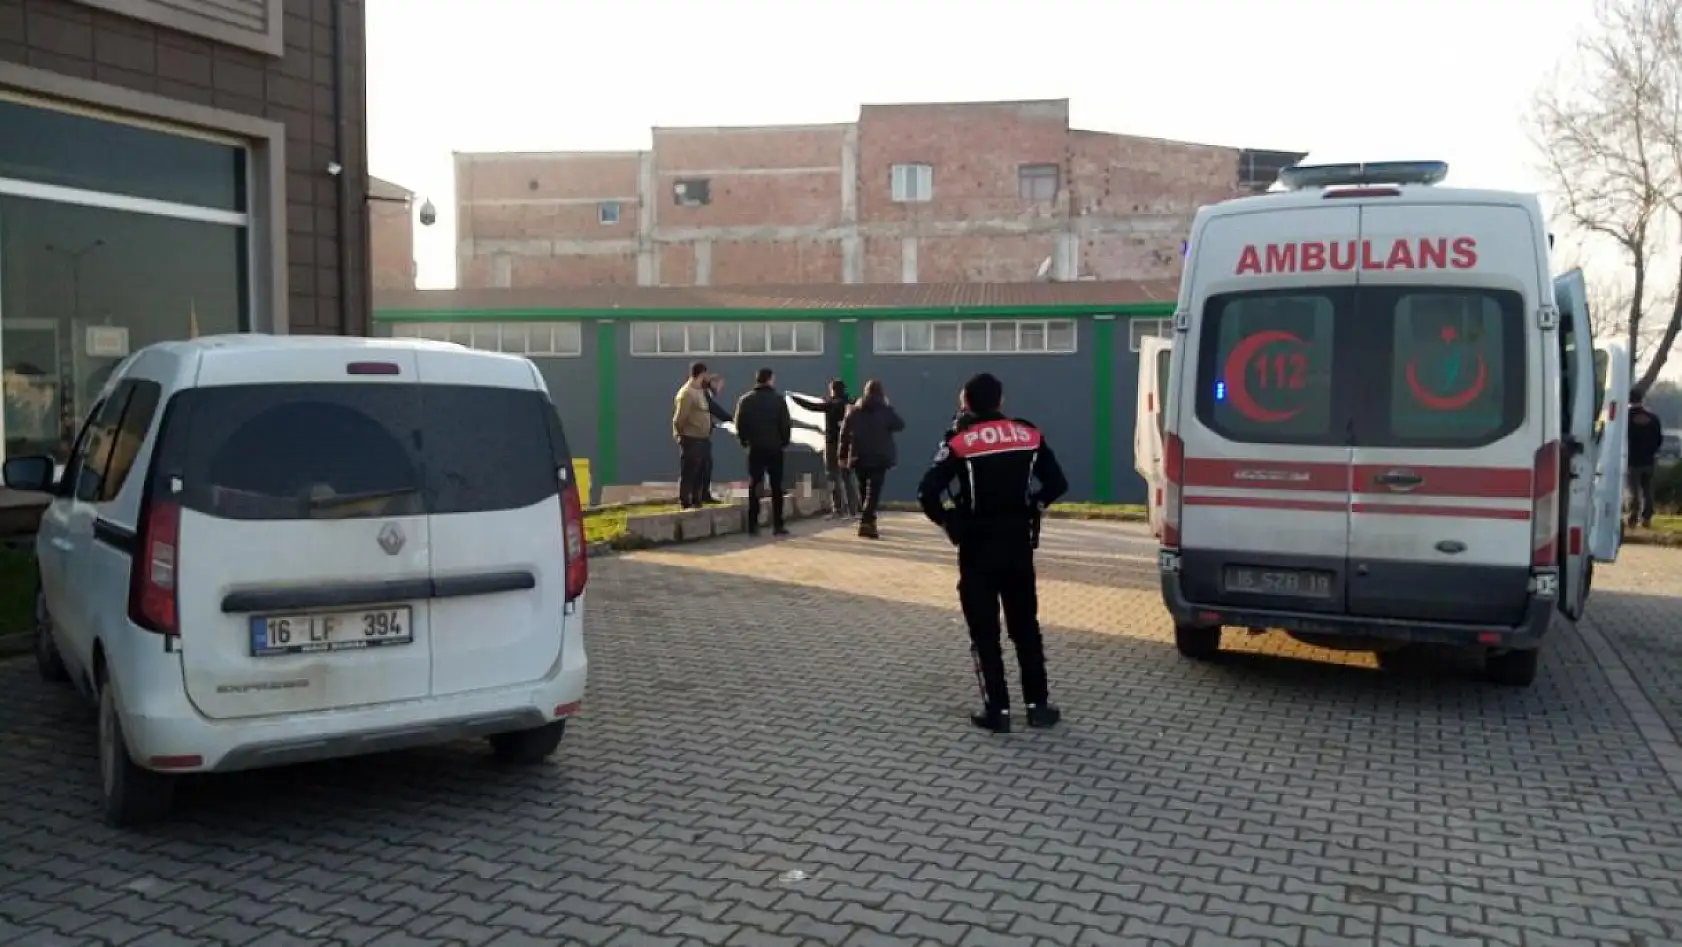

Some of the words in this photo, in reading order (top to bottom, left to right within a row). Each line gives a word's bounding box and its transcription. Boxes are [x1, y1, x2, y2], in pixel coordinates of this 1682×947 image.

[1235, 237, 1478, 275] AMBULANS
[1254, 353, 1308, 389] 112
[268, 619, 291, 645] 16
[310, 617, 335, 642] LF
[364, 613, 401, 636] 394
